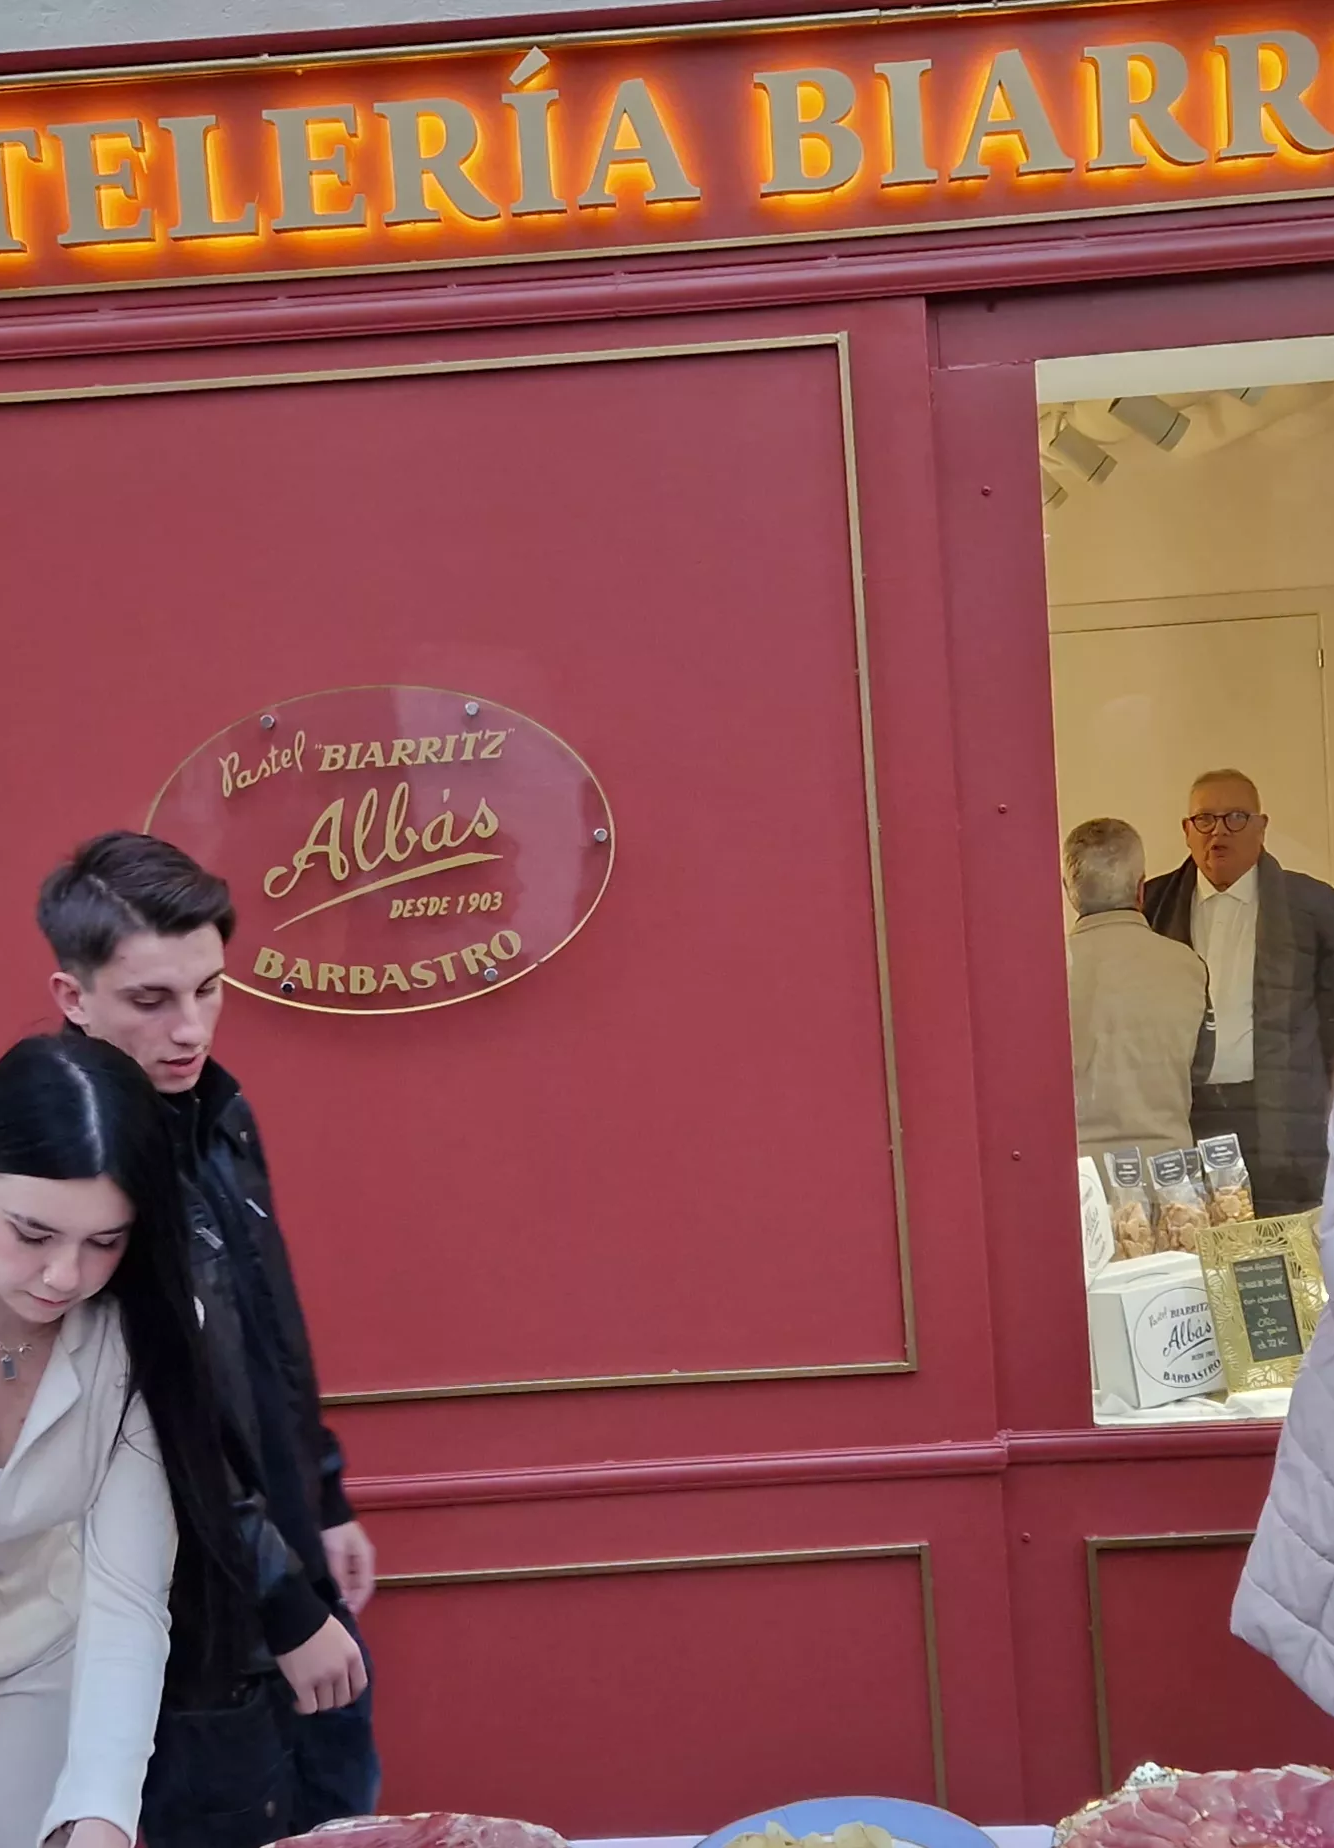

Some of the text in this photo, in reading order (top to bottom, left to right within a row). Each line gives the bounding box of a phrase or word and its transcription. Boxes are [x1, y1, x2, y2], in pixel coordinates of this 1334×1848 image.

[219, 730, 305, 798] Pastel
[263, 781, 499, 898] Albás
[388, 891, 504, 919] DESDE 1903
[253, 930, 522, 994] BARBASTRO
[1163, 1359, 1221, 1383] BARBASTRO
